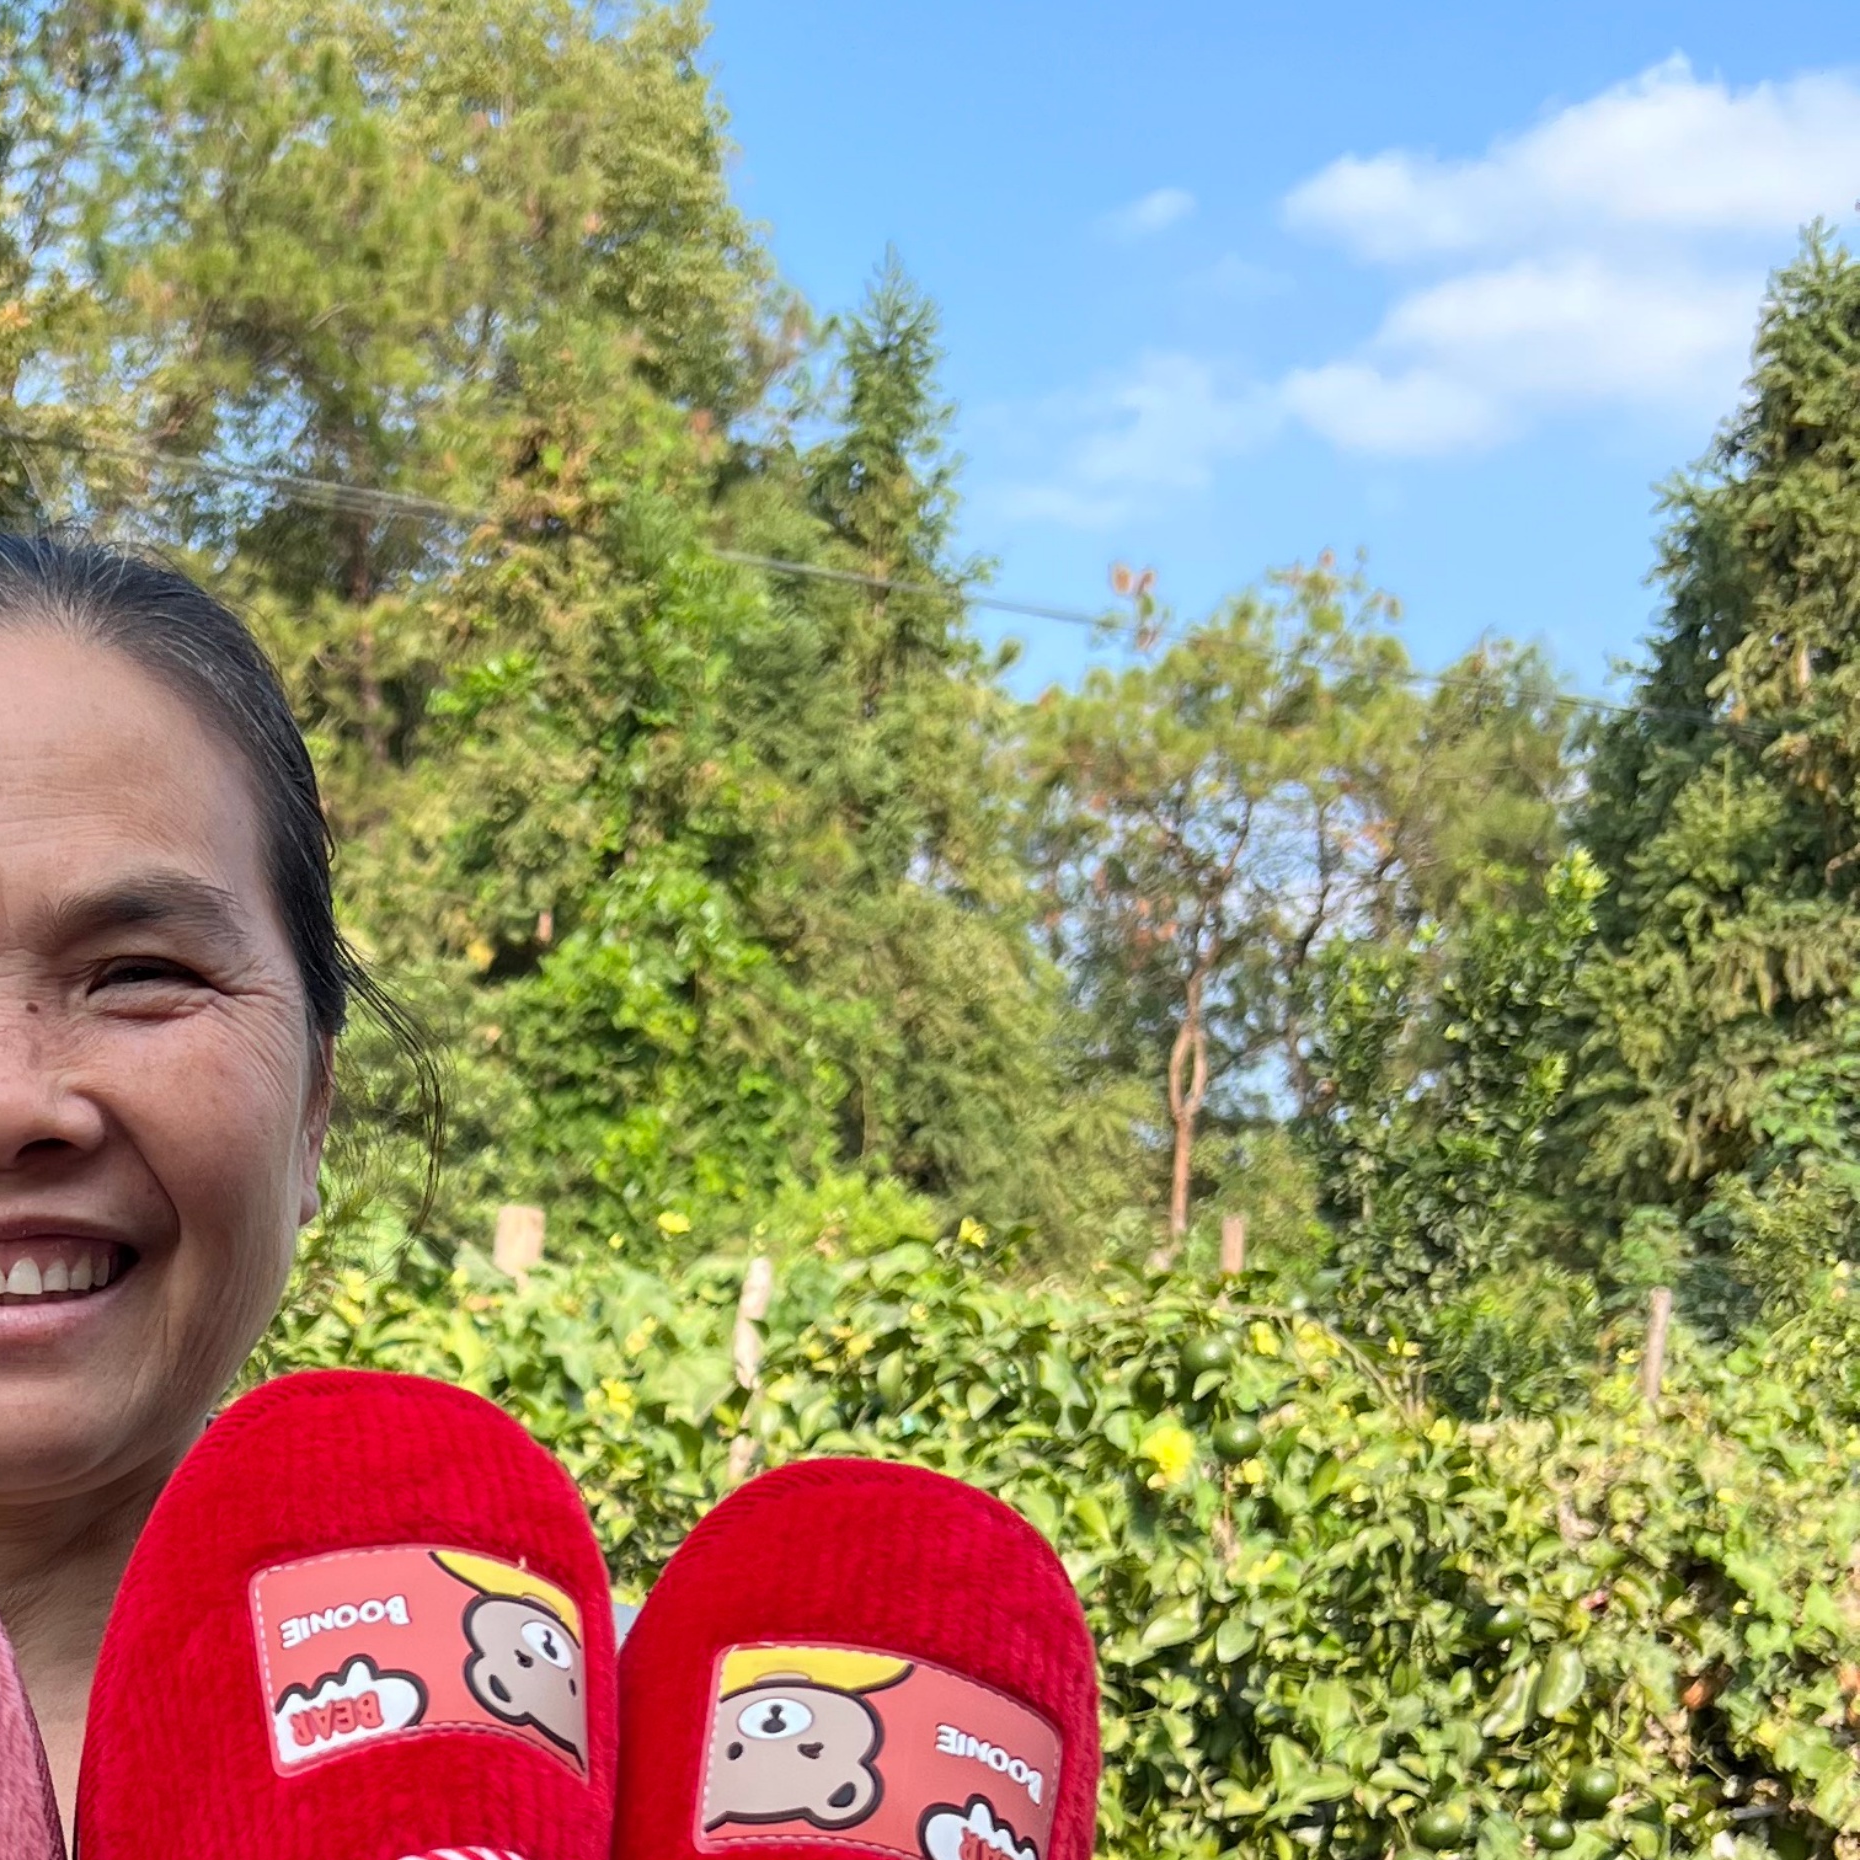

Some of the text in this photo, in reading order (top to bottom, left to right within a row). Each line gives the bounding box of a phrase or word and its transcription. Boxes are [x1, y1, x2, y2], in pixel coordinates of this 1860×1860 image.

[279, 1594, 411, 1649] BOONIE
[290, 1690, 384, 1746] BEAR
[935, 1723, 1042, 1806] BOONIE
